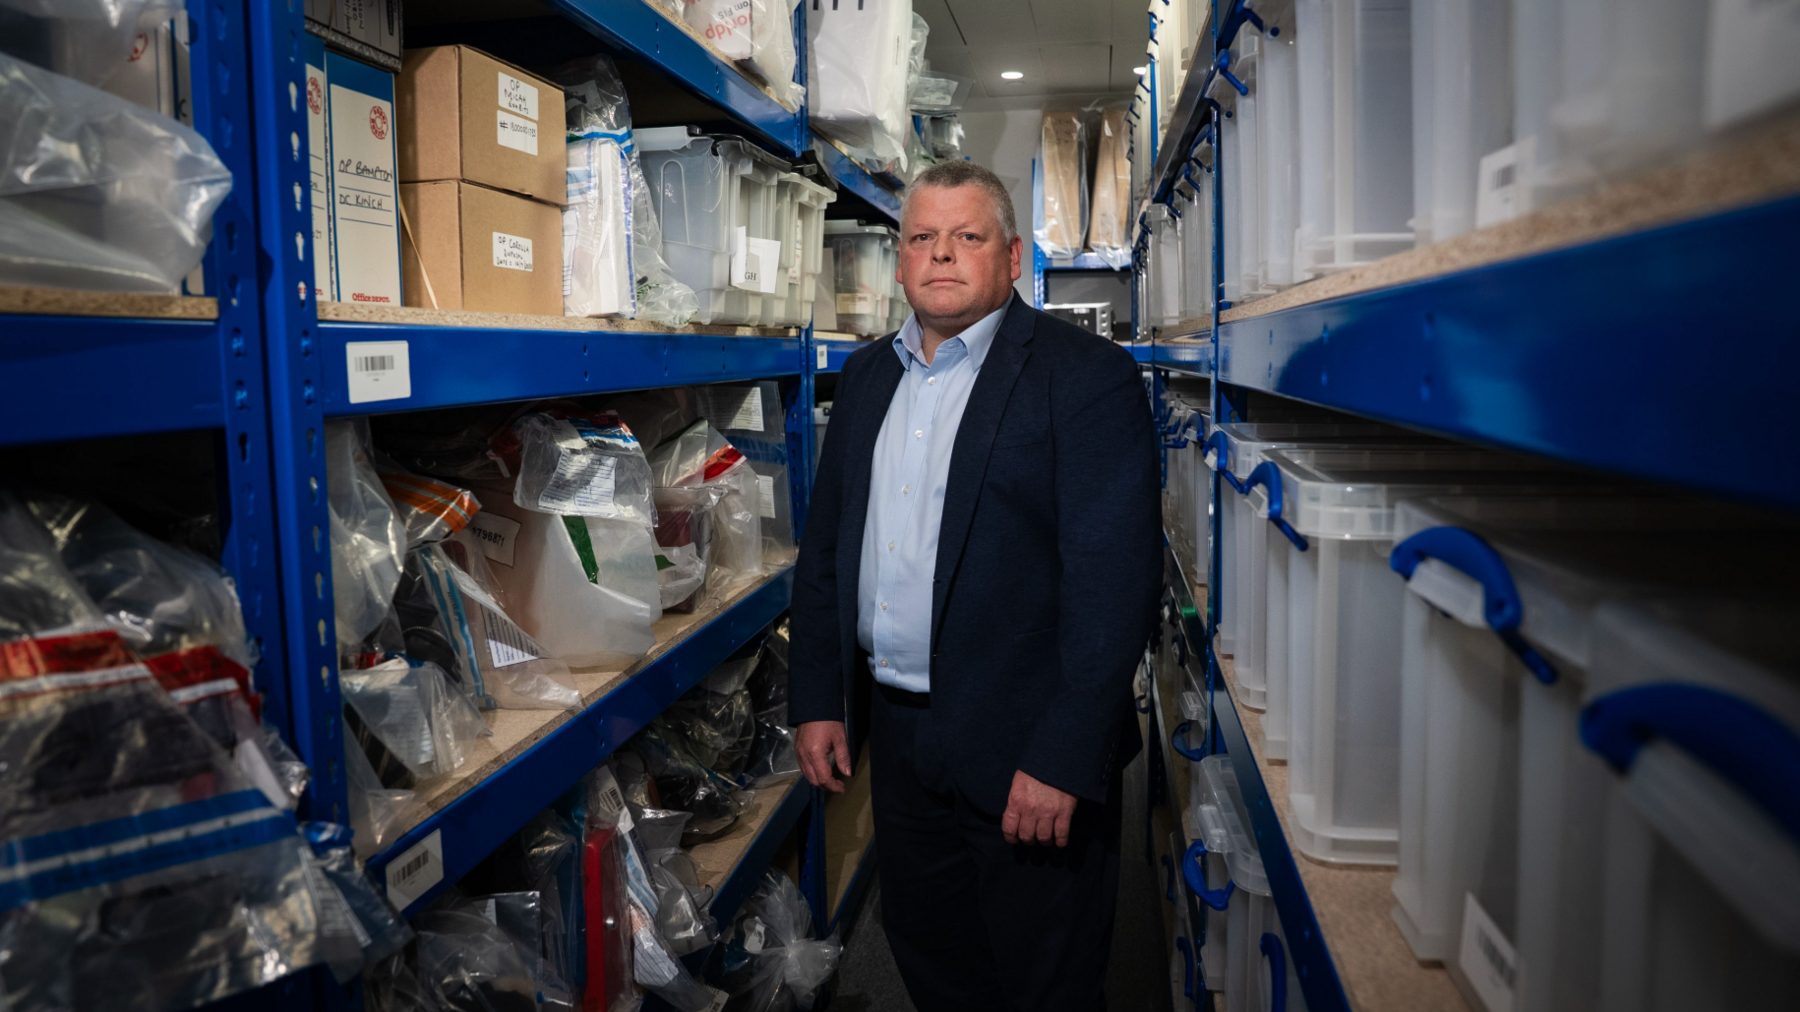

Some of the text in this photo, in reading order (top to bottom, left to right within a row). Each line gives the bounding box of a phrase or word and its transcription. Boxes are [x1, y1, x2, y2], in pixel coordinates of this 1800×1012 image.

[510, 79, 520, 92] OP
[339, 159, 393, 181] OP BAMPTON
[339, 193, 383, 210] DC KINCH
[498, 235, 507, 245] OP
[352, 292, 371, 303] Office
